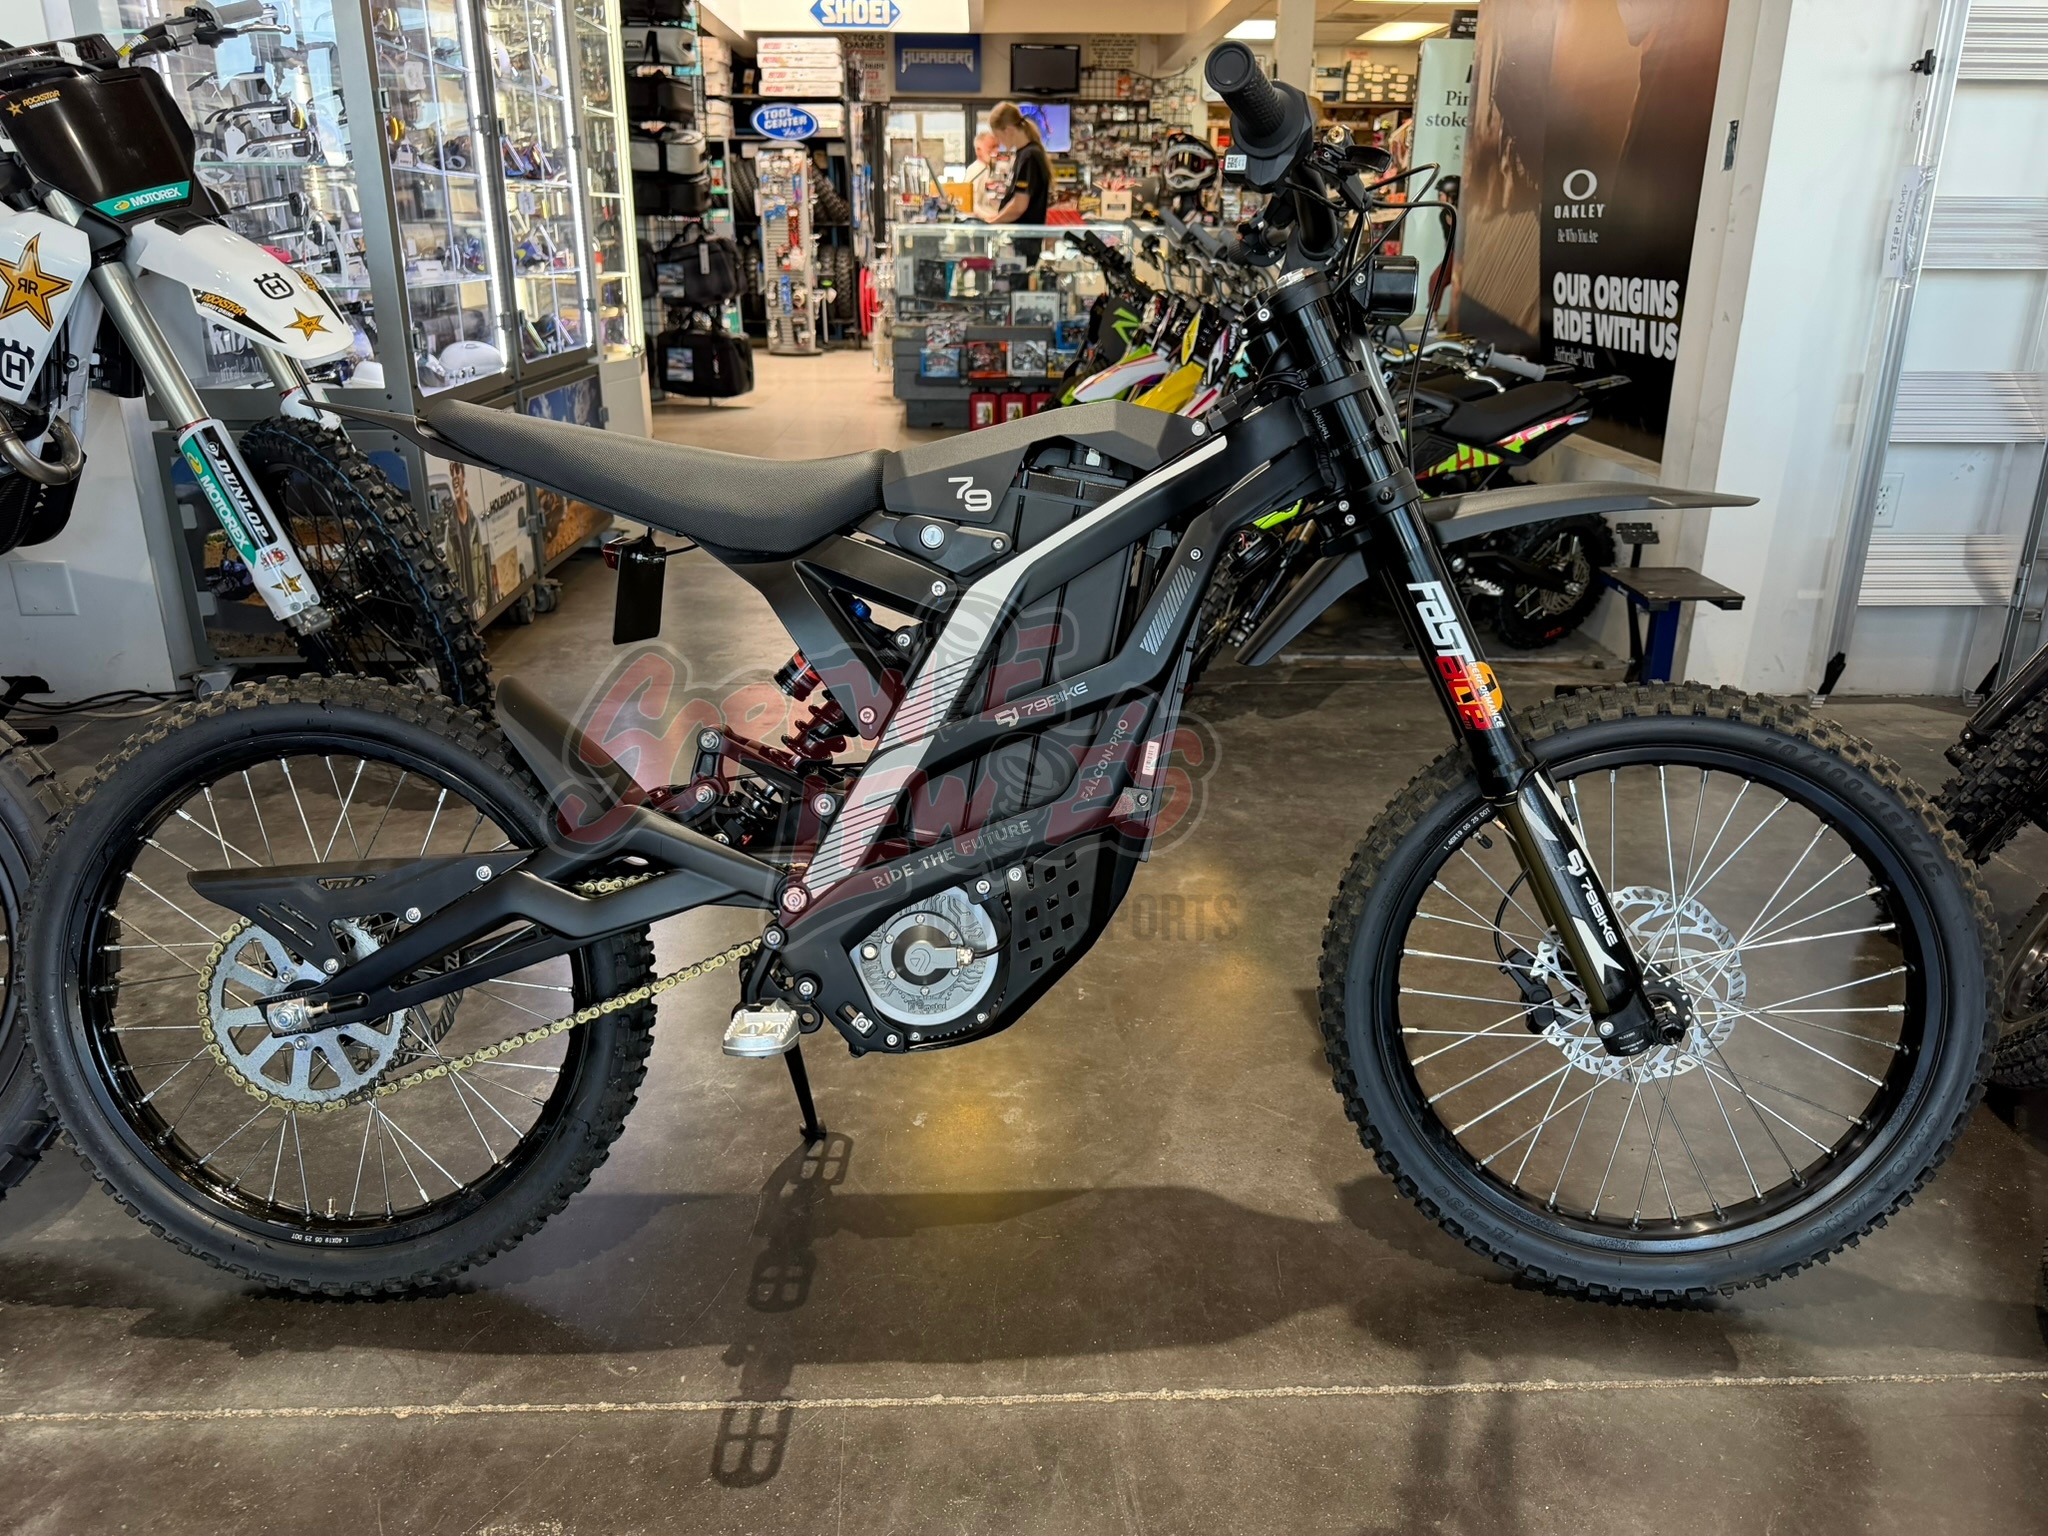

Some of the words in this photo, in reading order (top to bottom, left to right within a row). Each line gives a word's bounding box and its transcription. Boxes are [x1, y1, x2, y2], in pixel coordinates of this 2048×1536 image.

[820, 0, 891, 24] SHOEI
[901, 50, 975, 74] HUSABERG
[22, 89, 61, 107] ROCKSTAR
[763, 108, 793, 120] TOOL
[764, 115, 808, 130] CENTER
[129, 187, 182, 207] MOTOREX
[1553, 203, 1605, 219] OAKLEY
[1894, 184, 1908, 224] RAMP
[1565, 229, 1578, 243] Who
[1578, 230, 1590, 244] You
[1889, 226, 1901, 262] STEP
[201, 292, 248, 317] ROCKSTAR
[1552, 271, 1592, 308] OUR
[1593, 274, 1680, 320] ORIGINS
[1552, 307, 1593, 345] RIDE
[1594, 312, 1646, 355] WITH
[1650, 321, 1679, 361] US
[199, 474, 251, 549] MOTOREX
[214, 457, 270, 539] DUNLOP
[489, 487, 520, 515] HOLBROOK
[948, 476, 992, 512] 79
[1021, 681, 1089, 716] 79BIKE
[1468, 661, 1506, 729] PERFORMANCE
[1079, 718, 1129, 802] FALCON-PRO
[1479, 807, 1491, 818] DOT
[871, 862, 915, 890] RIDE
[917, 846, 956, 870] THE
[960, 819, 1031, 855] FUTURE
[1581, 876, 1619, 948] 79BIKE
